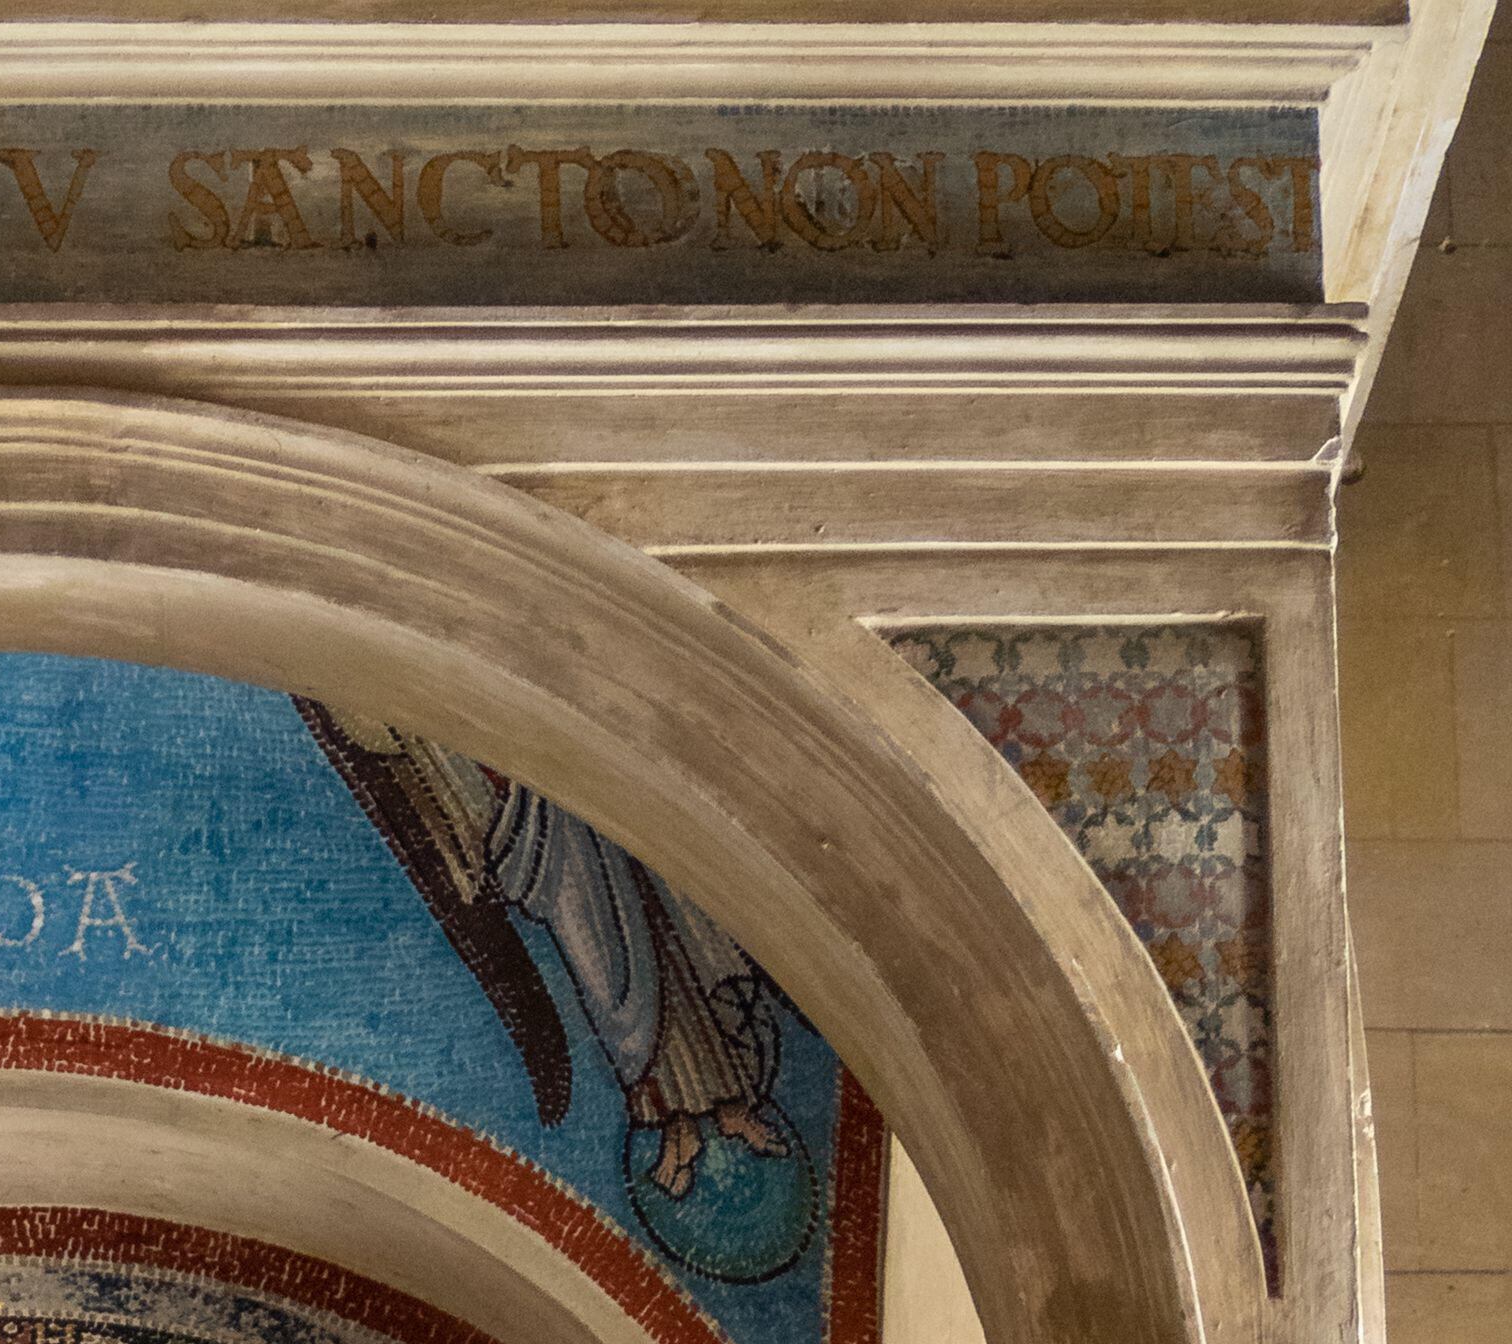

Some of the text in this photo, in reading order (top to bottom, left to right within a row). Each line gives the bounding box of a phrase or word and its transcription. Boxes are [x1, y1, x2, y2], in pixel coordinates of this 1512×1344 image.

[166, 144, 701, 251] SANCTO
[704, 147, 948, 256] NON
[972, 151, 1322, 257] POTEST
